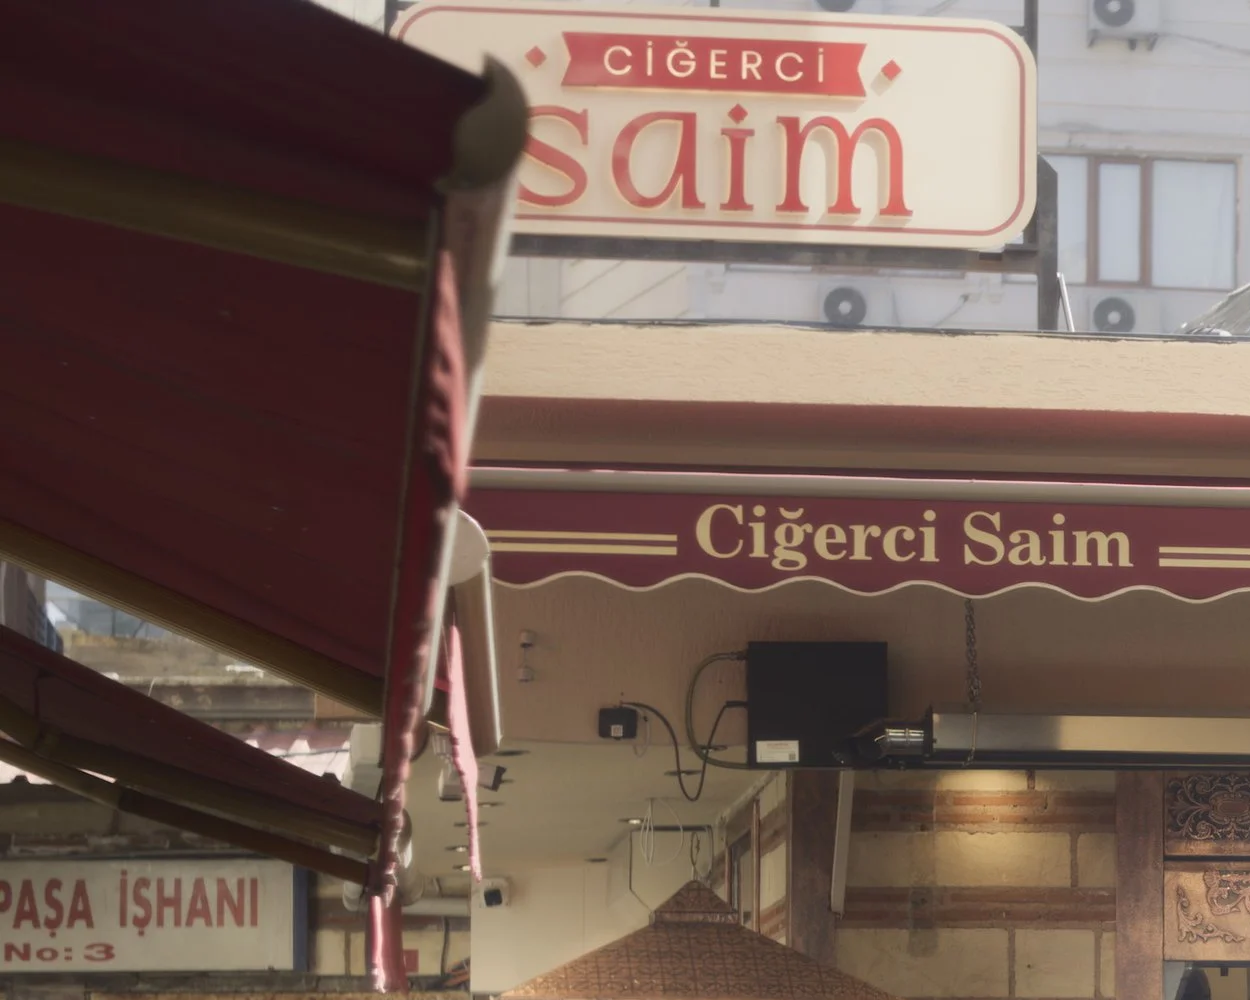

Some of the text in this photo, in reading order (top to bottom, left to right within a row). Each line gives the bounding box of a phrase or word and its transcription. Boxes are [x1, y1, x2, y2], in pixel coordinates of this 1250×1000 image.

[603, 40, 826, 84] CİĞERCİ
[516, 103, 914, 218] saim
[695, 503, 1135, 571] Ciğerci Saim
[118, 869, 259, 937] İŞHANI
[83, 943, 116, 962] 3
